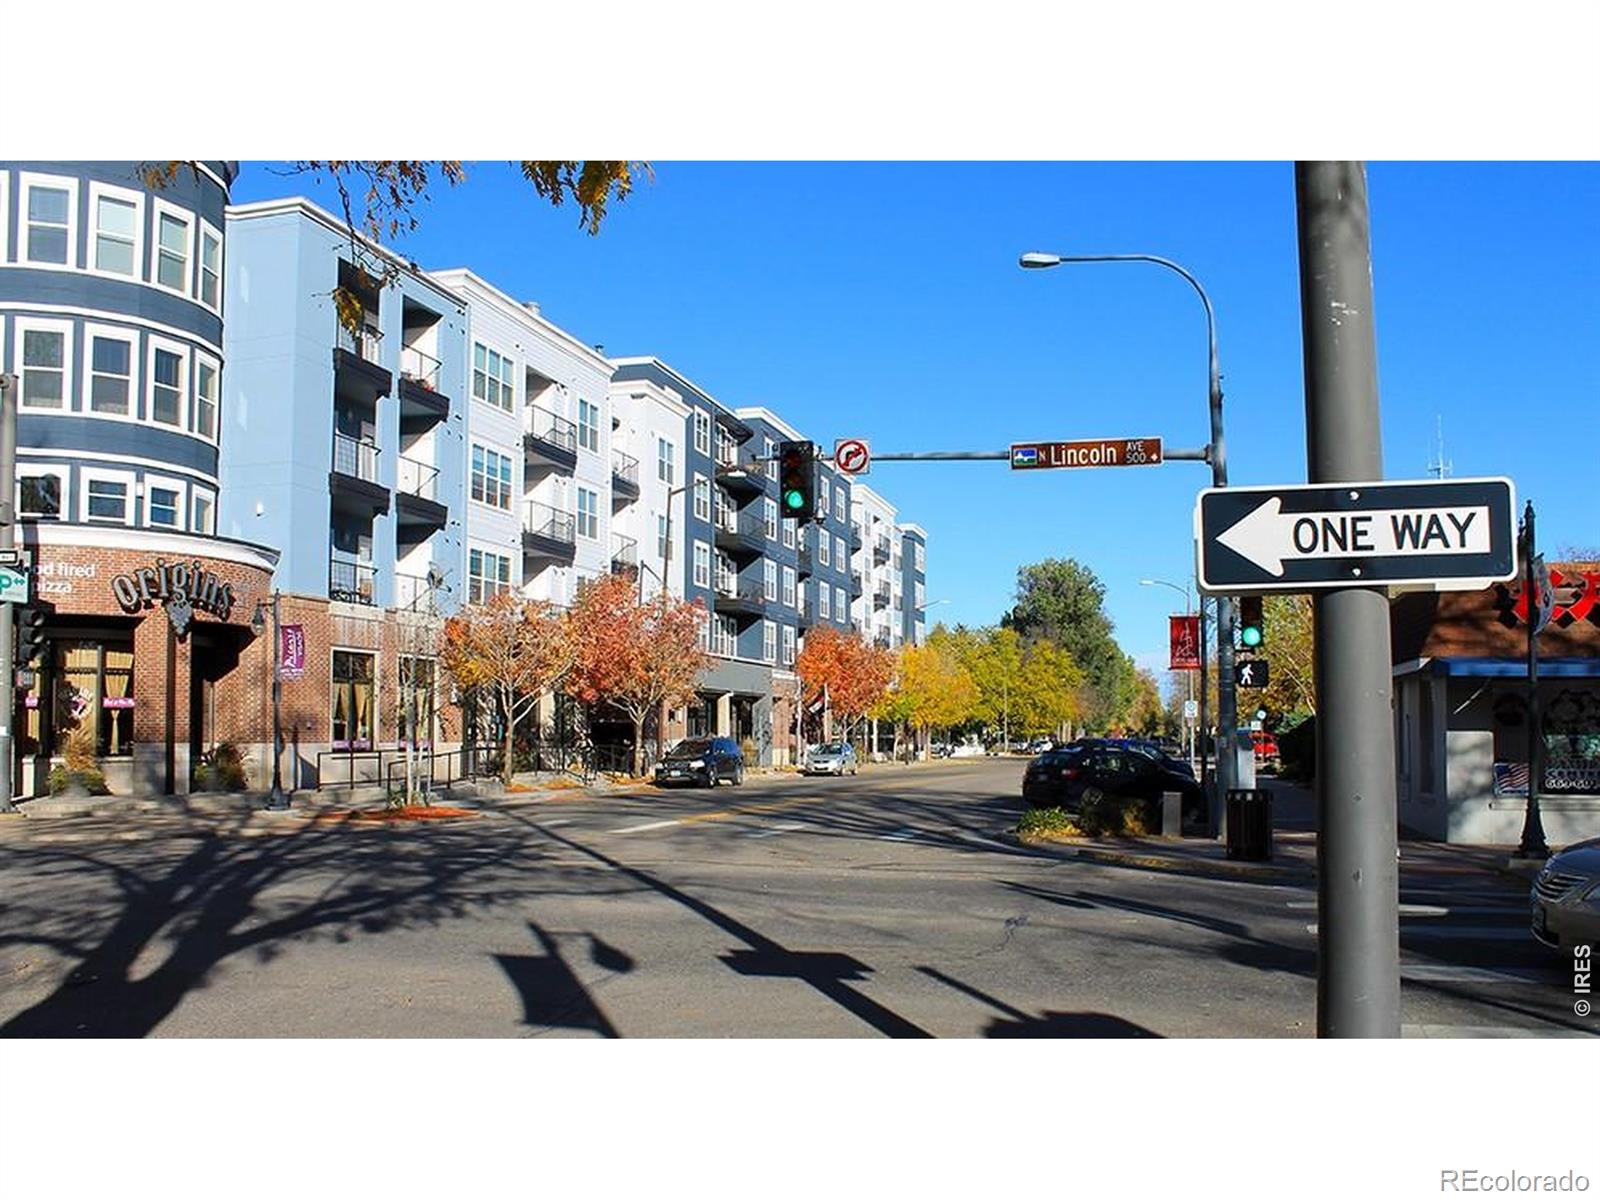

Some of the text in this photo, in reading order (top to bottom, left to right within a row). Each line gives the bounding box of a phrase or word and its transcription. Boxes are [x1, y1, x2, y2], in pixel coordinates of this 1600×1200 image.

[1050, 443, 1118, 466] Lincoln
[1125, 440, 1145, 453] AVE
[1125, 452, 1147, 464] 500
[1293, 511, 1477, 554] ONE WAY
[58, 562, 95, 578] fired
